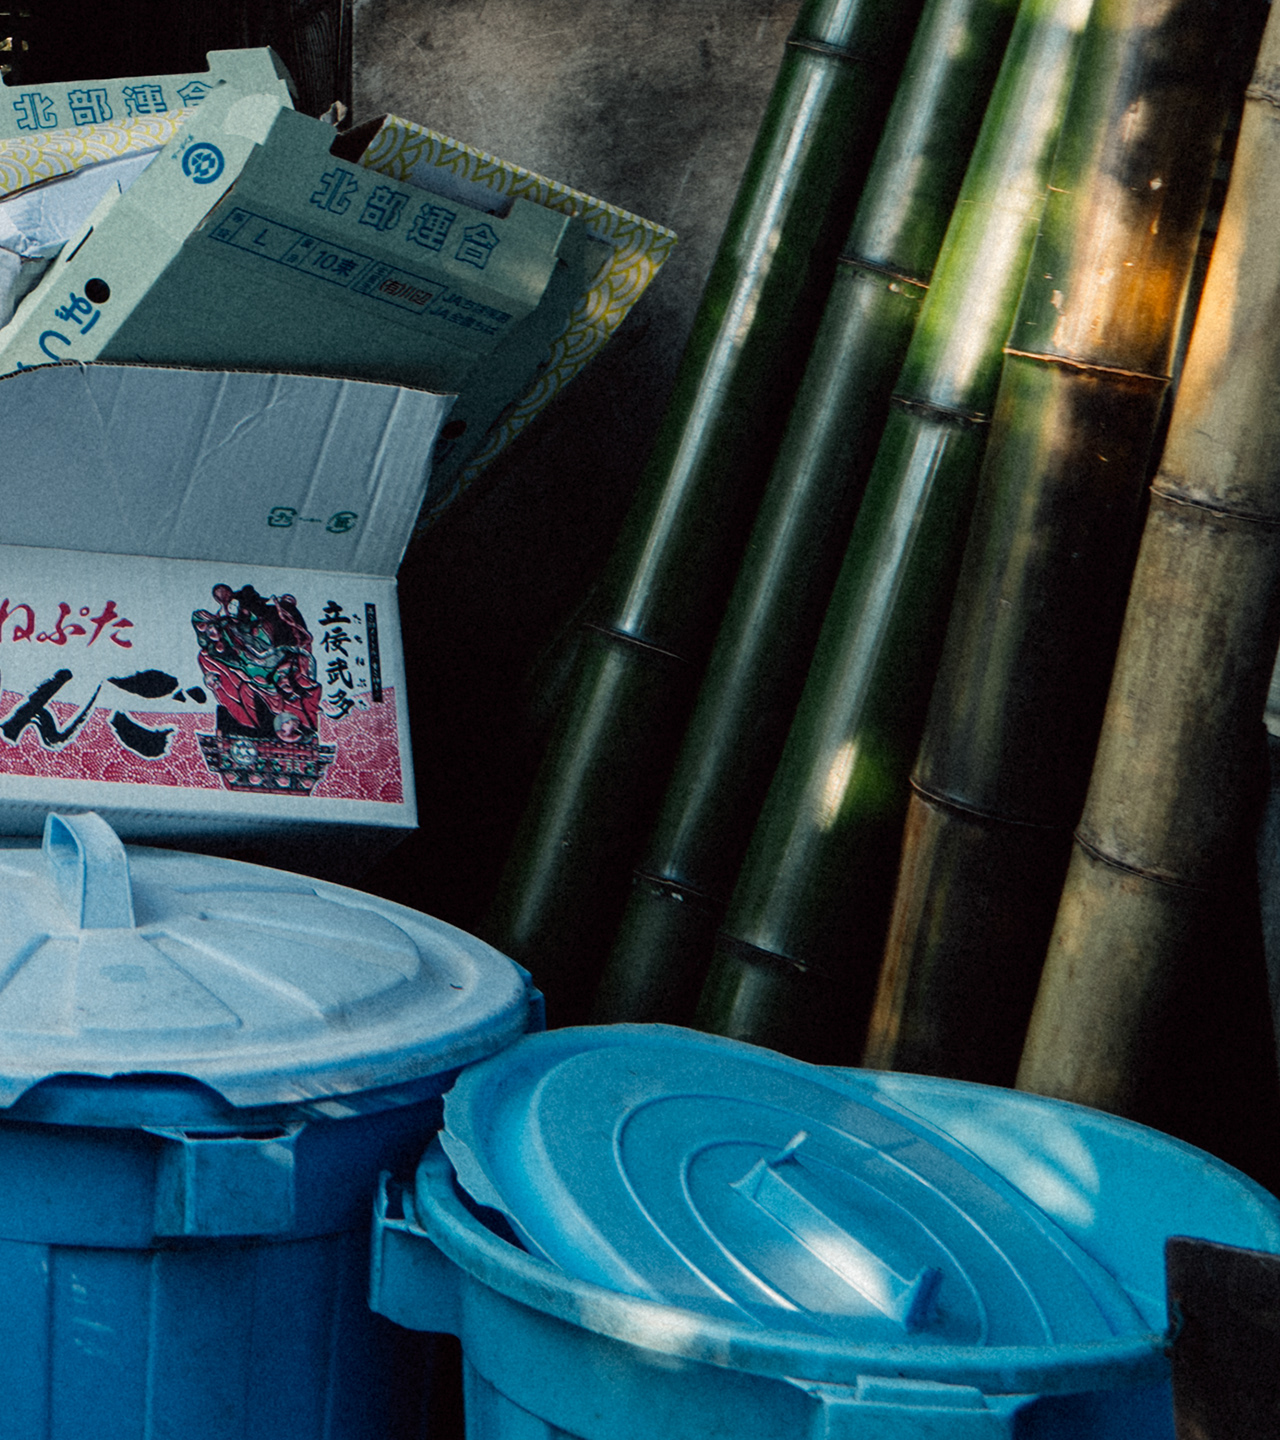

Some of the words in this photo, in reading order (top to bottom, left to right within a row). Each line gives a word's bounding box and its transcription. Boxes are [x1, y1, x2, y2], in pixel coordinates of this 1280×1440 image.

[253, 228, 270, 246] L
[310, 167, 500, 270] 北部連合
